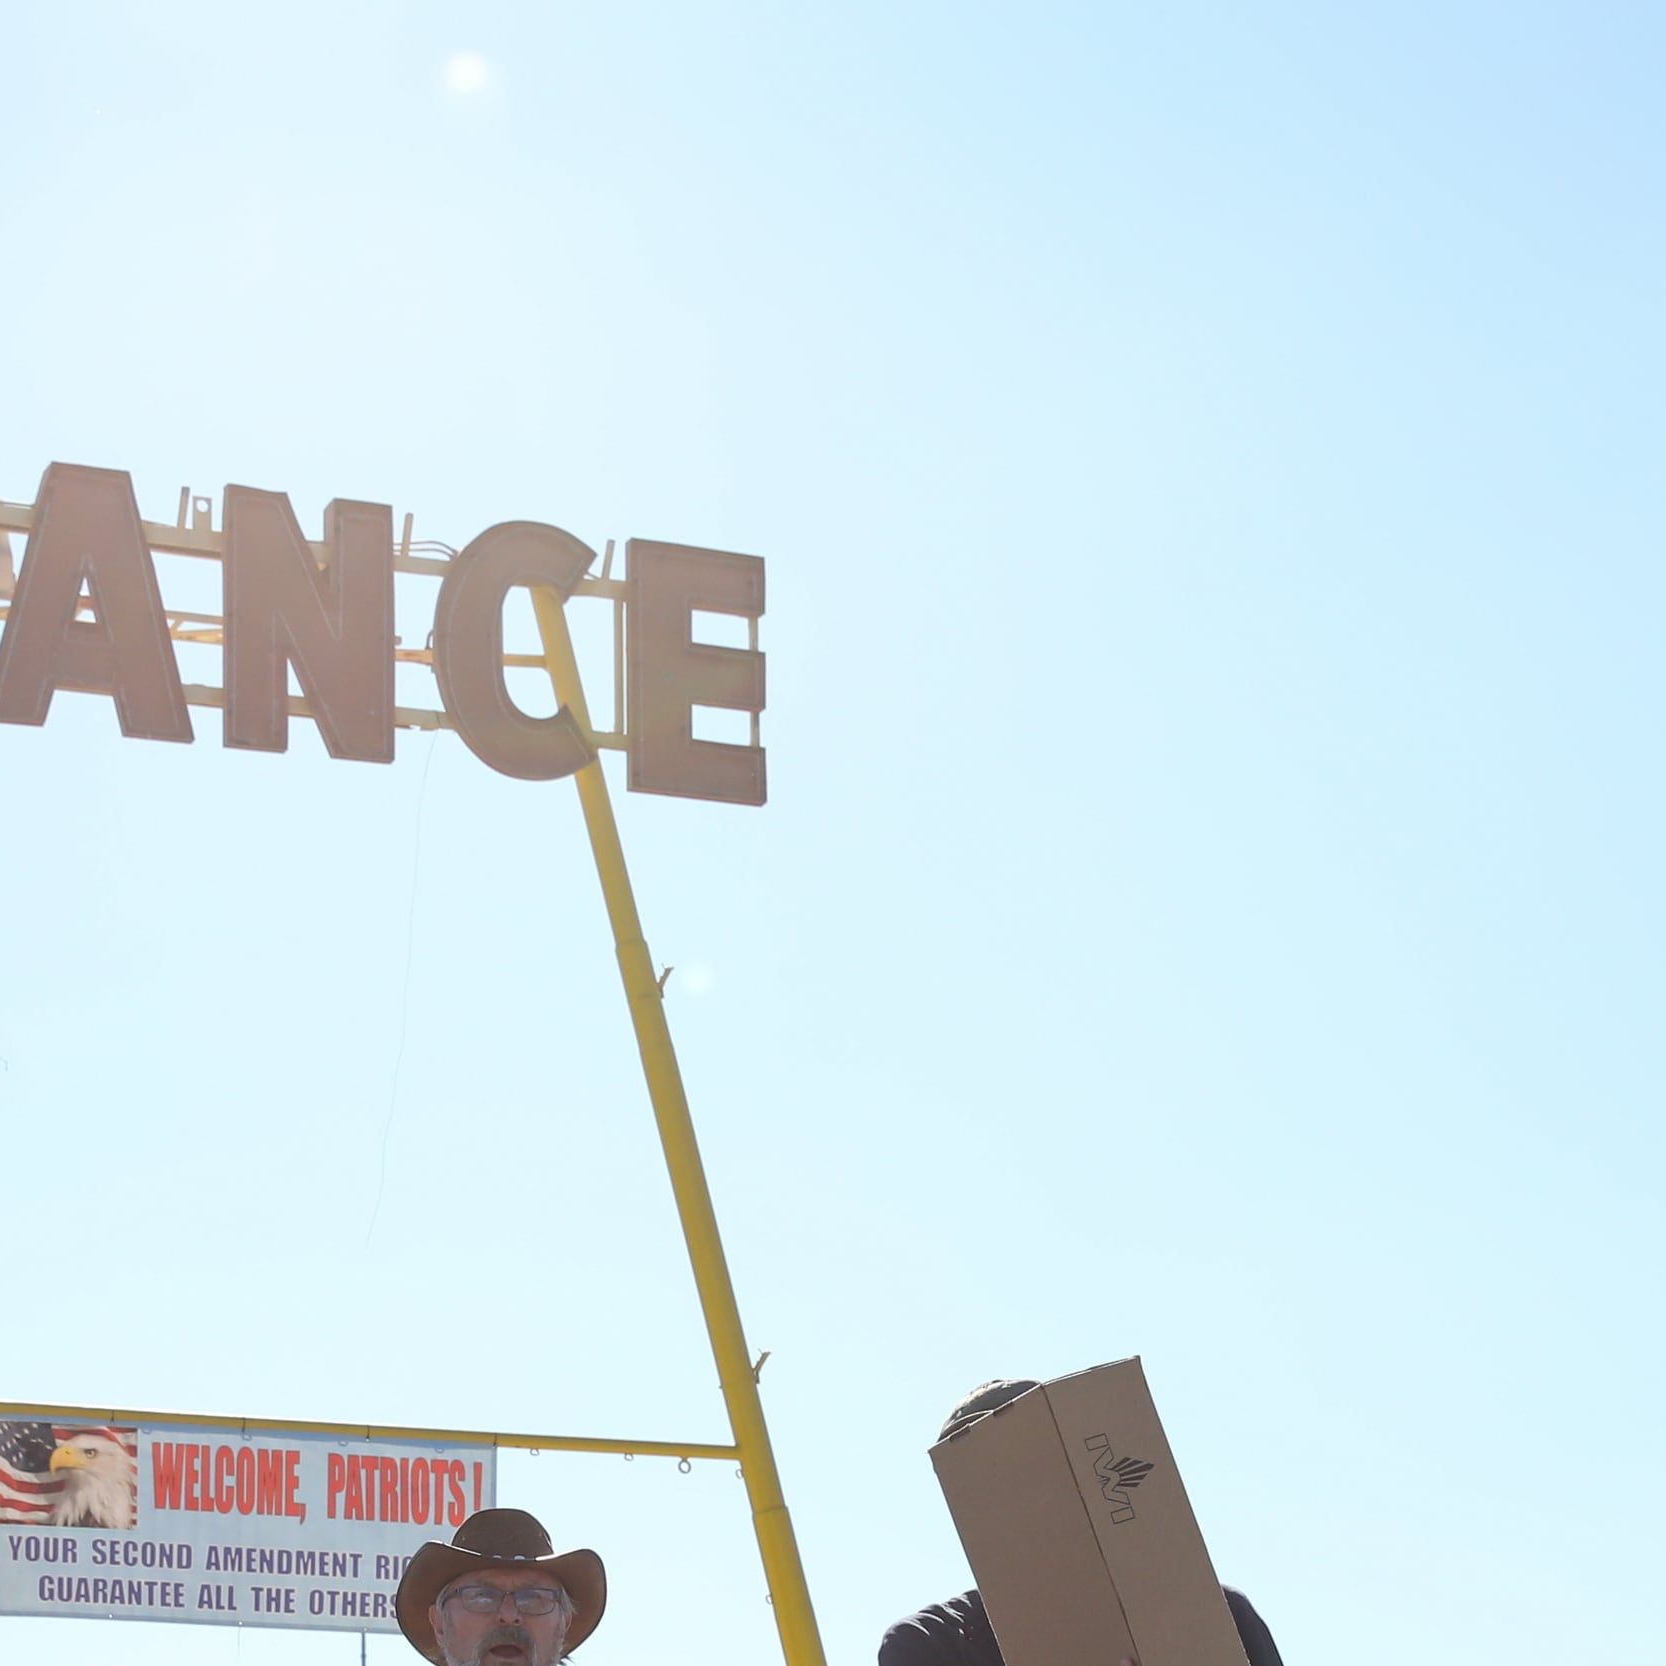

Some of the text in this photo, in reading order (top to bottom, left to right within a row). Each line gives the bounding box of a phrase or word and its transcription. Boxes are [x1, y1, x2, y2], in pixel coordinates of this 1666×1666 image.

[152, 1442, 307, 1526] WELCOME,
[8, 1535, 79, 1565] YOUR
[91, 1537, 193, 1570] SECOND
[205, 1546, 362, 1579] AMENDMENT
[38, 1575, 185, 1608] GUARANTEE
[198, 1583, 237, 1611] ALL
[250, 1586, 296, 1614] THE
